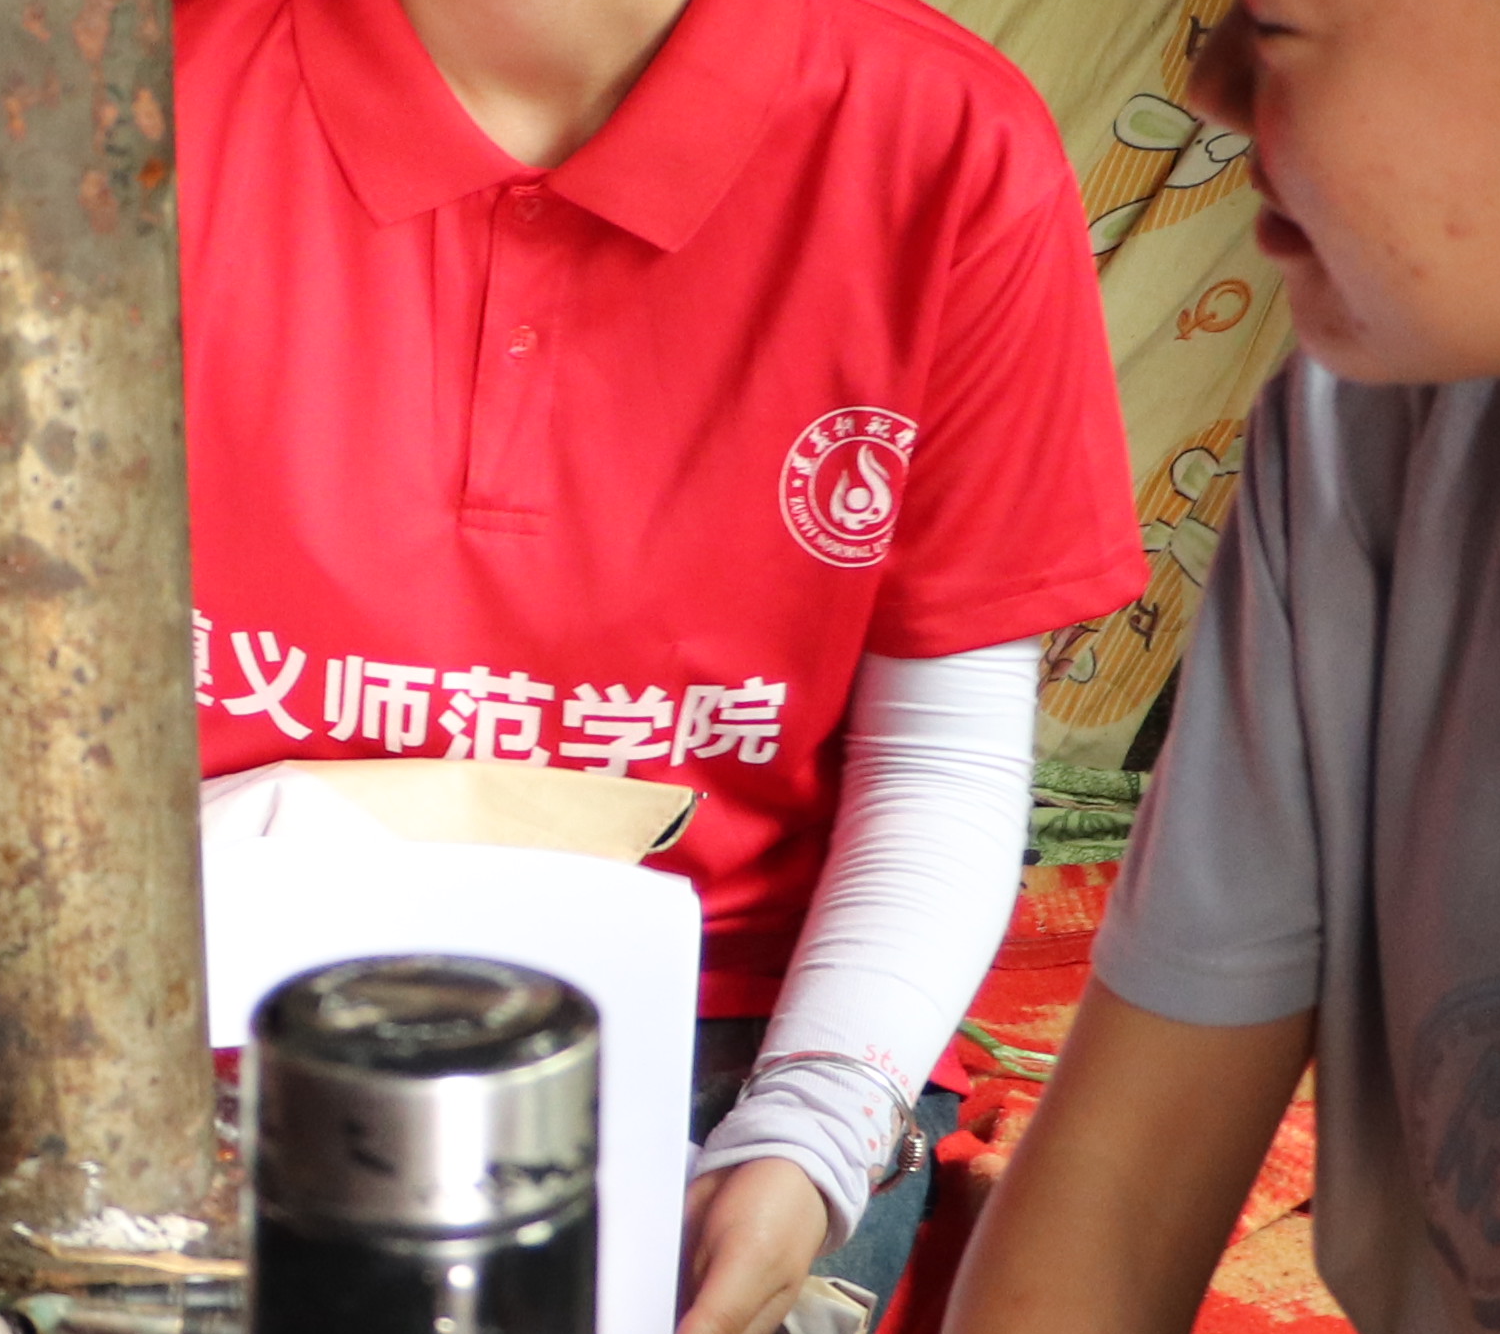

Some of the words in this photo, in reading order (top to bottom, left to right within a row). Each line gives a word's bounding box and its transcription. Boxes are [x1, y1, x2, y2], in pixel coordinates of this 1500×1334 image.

[192, 608, 787, 779] 义师范学院
